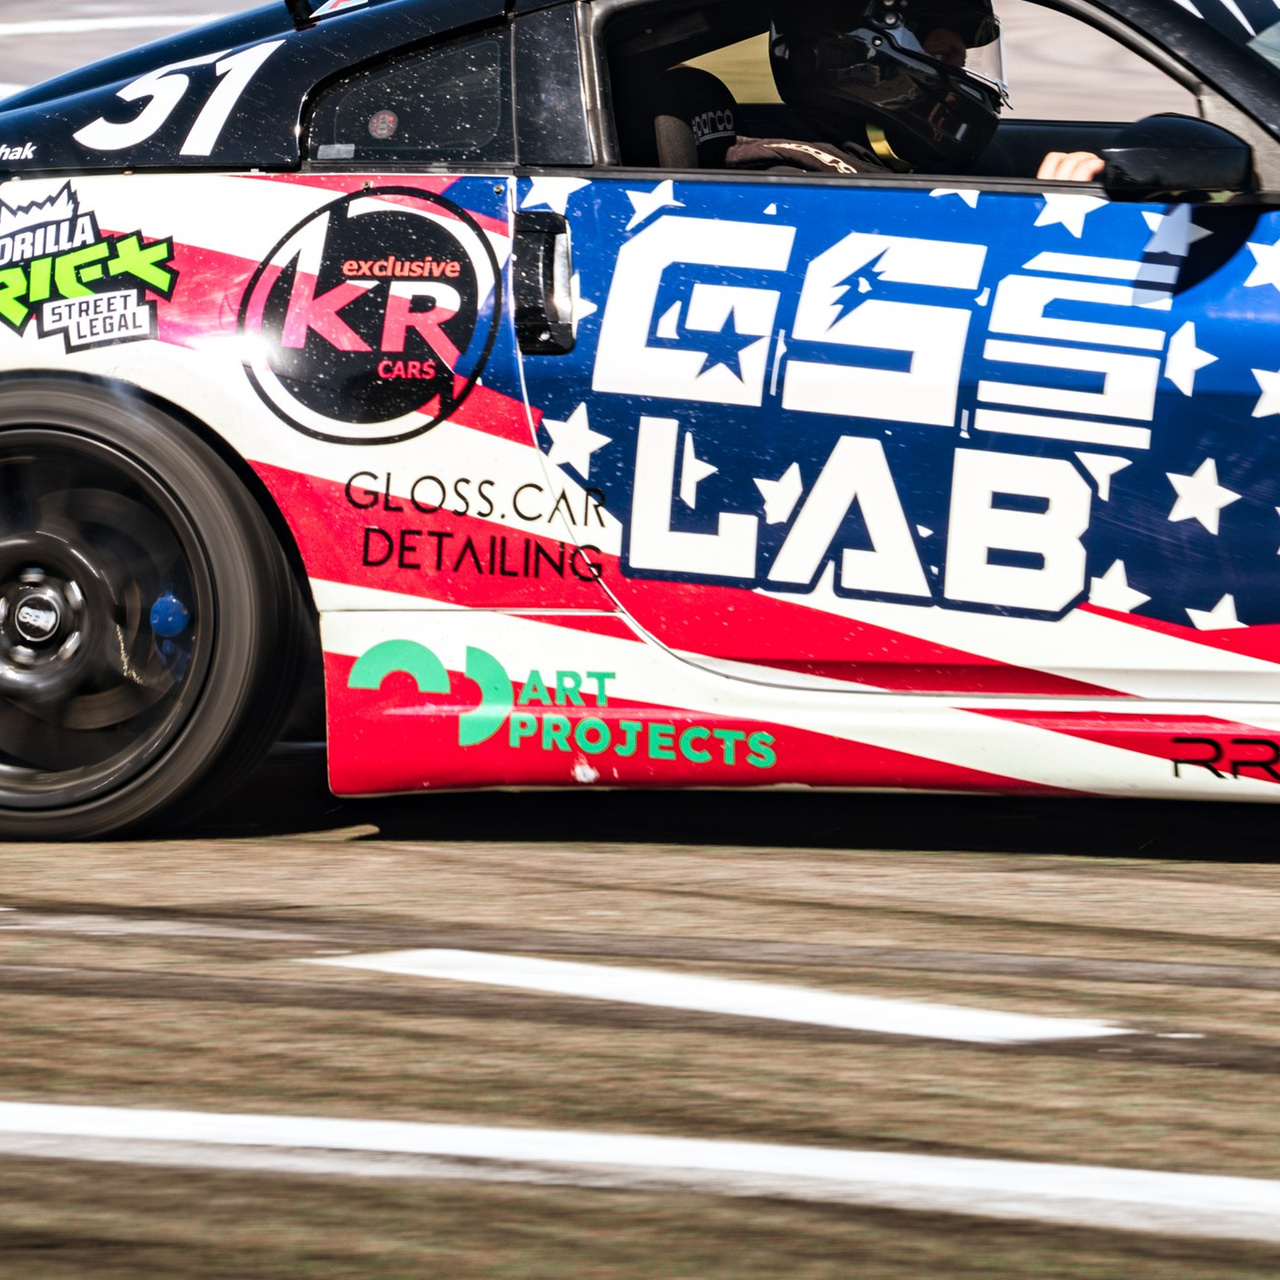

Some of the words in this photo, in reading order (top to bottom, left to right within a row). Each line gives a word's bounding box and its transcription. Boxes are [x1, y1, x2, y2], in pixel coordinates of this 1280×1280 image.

[342, 255, 461, 278] exclusive
[51, 294, 132, 323] STREET
[77, 312, 142, 339] LEGAL
[377, 360, 437, 380] CARS
[344, 471, 606, 528] GLOSS.CAR
[629, 415, 1092, 612] LAB
[361, 527, 603, 582] DETAILING
[518, 669, 616, 707] ART
[508, 712, 777, 768] PROJECTS
